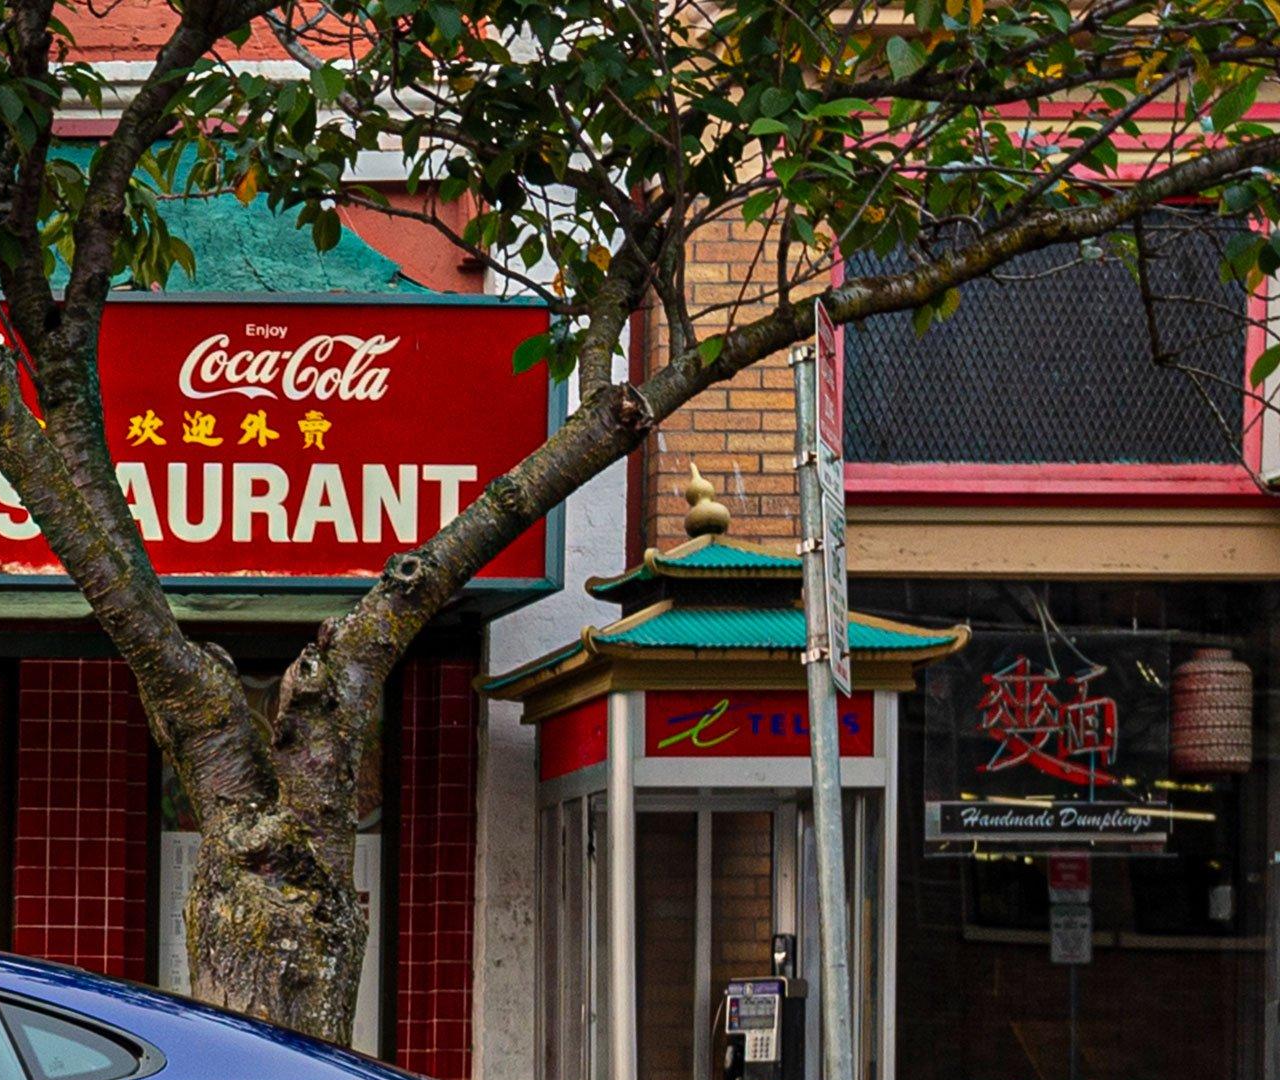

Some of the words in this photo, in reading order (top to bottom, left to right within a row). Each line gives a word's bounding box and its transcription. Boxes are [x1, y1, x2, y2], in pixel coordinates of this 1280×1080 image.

[246, 324, 287, 339] Enjoy
[179, 334, 401, 401] Coca-Cola
[748, 713, 861, 736] TELS
[960, 806, 1054, 828] Handmade
[1059, 807, 1152, 833] Dumplings
